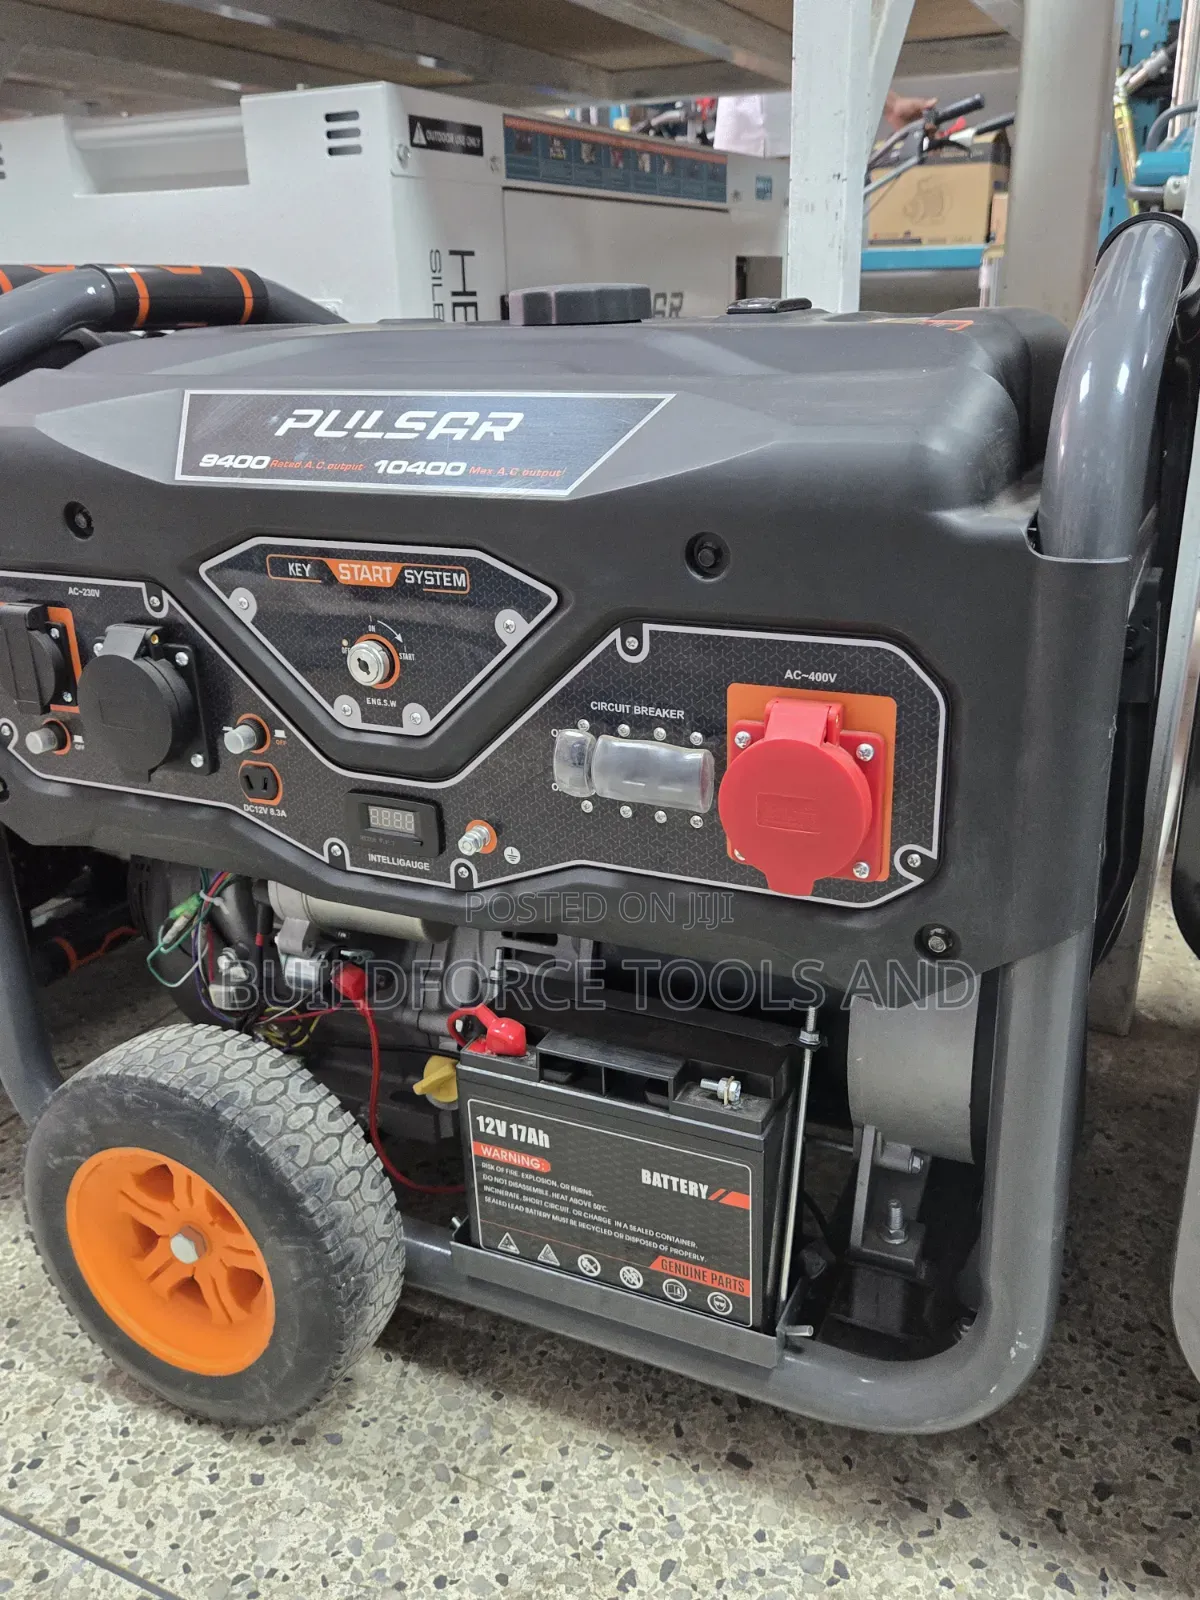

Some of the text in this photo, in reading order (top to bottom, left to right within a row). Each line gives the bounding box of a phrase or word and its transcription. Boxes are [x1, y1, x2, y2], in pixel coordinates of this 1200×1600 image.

[274, 409, 525, 442] PULSAR
[199, 454, 271, 469] 9400
[270, 459, 302, 469] Rated
[327, 463, 365, 472] output
[374, 459, 467, 477] 10400
[469, 466, 493, 476] Max
[522, 468, 563, 478] output
[288, 562, 466, 588] KEY START SYSTEM
[399, 653, 415, 661] START
[366, 697, 397, 708] ENG.S.W
[590, 702, 685, 720] CIRCUIT BREAKER
[243, 803, 287, 818] DC12V 8.3A
[368, 853, 431, 871] INTELLIGAUGE
[476, 1115, 550, 1149] 12V 17Ah
[480, 1144, 546, 1171] WARNING:
[481, 1161, 495, 1171] RISK
[496, 1165, 504, 1173] OF
[560, 1182, 570, 1190] OR
[641, 1168, 709, 1200] BATTERY
[482, 1173, 494, 1182] DO
[494, 1176, 508, 1185] NOT
[552, 1192, 568, 1201] HEAT
[569, 1196, 592, 1208] ABOVE
[484, 1195, 507, 1208] SEALED
[508, 1202, 524, 1212] LEAD
[525, 1207, 551, 1220] BATTERY
[551, 1214, 568, 1224] MUST
[570, 1219, 577, 1227] BE
[578, 1221, 613, 1236] RECYCLED
[613, 1231, 624, 1239] OR
[625, 1234, 658, 1249] DISPOSED
[659, 1244, 668, 1252] OF
[522, 1195, 543, 1206] SHORT
[572, 1209, 582, 1217] OR
[583, 1212, 611, 1225] CHARGE
[614, 1220, 622, 1228] IN
[622, 1222, 629, 1230] A
[629, 1224, 654, 1237] SEALED
[661, 1258, 745, 1293] GENUINE PARTS
